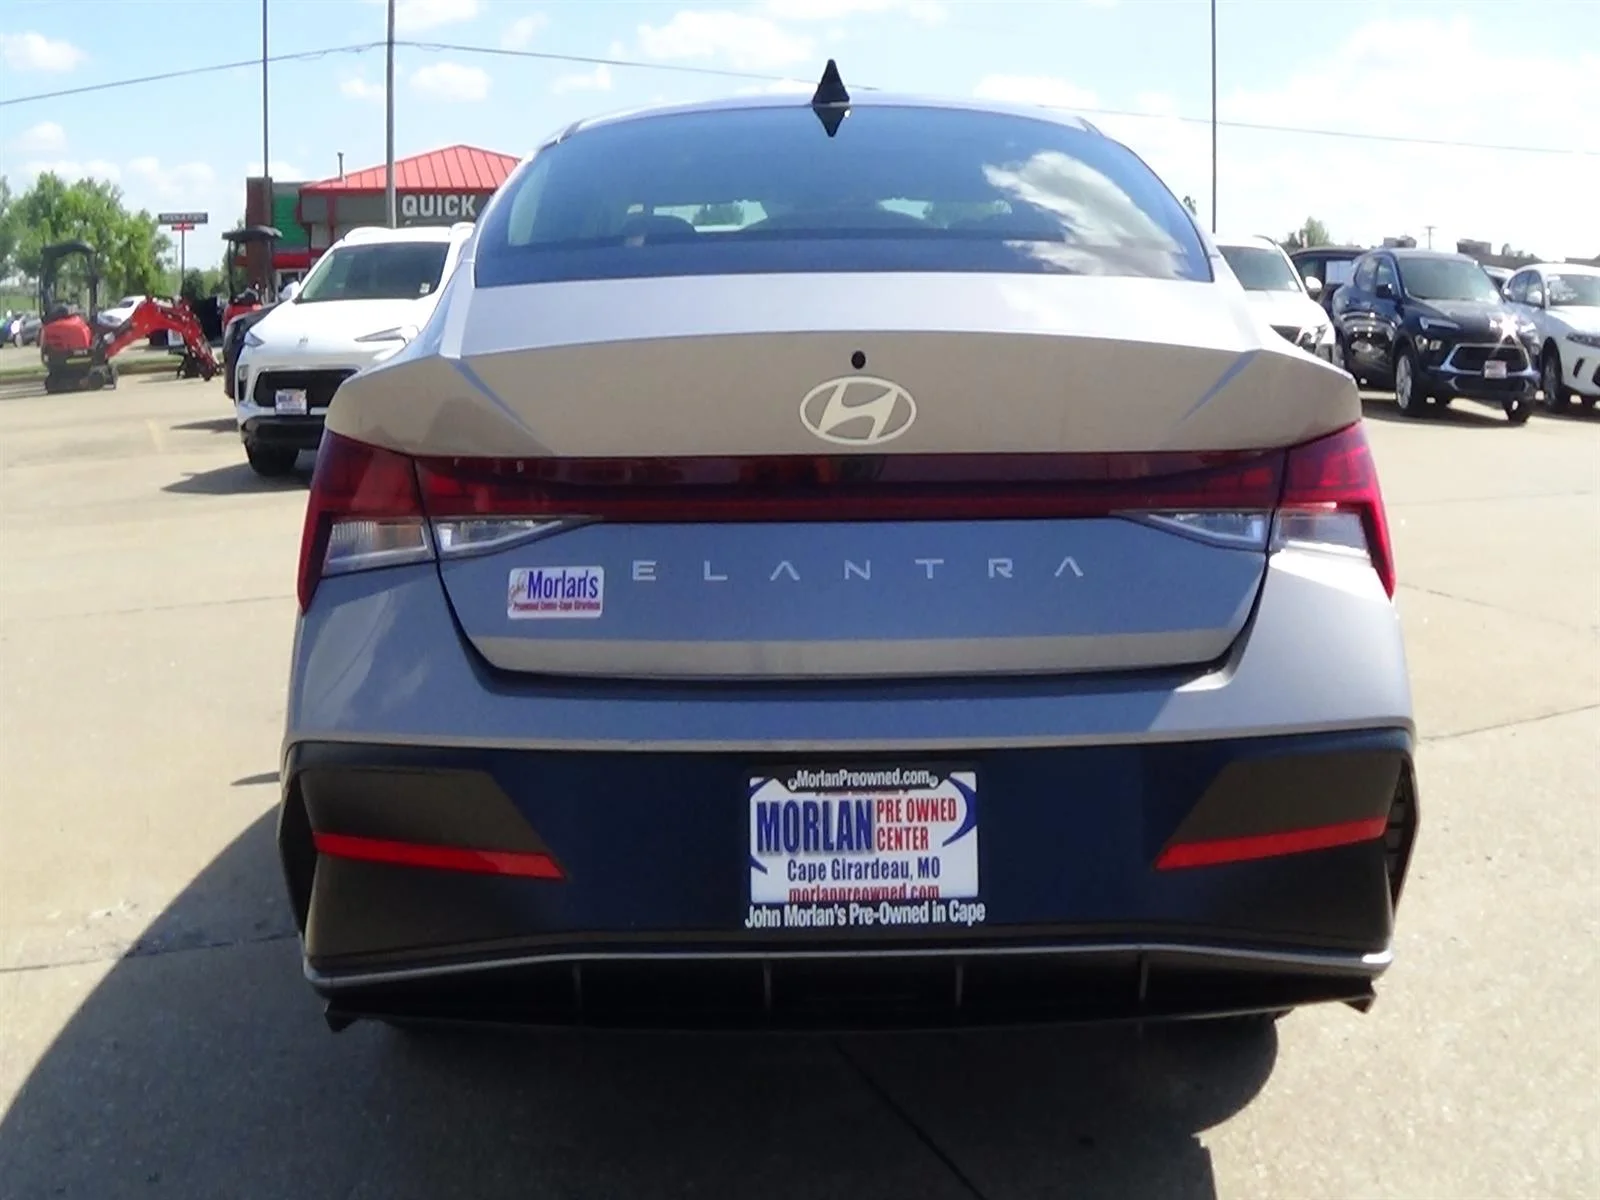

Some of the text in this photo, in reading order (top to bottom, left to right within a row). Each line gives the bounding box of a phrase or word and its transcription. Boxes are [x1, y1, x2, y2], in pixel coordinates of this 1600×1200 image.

[402, 195, 476, 217] QUICK
[632, 556, 1084, 581] ELANTRA
[527, 570, 599, 599] Morlan's
[796, 768, 930, 788] MorlanPreowned.com
[876, 798, 957, 822] PRE OWNED
[756, 799, 874, 853] MORLAN
[876, 827, 929, 851] CENTER
[787, 856, 941, 883] Cape Girardeau, MO
[789, 883, 940, 901] morlanpreownedcom
[745, 899, 986, 928] John Morlan's Pre-Owned in Cape
